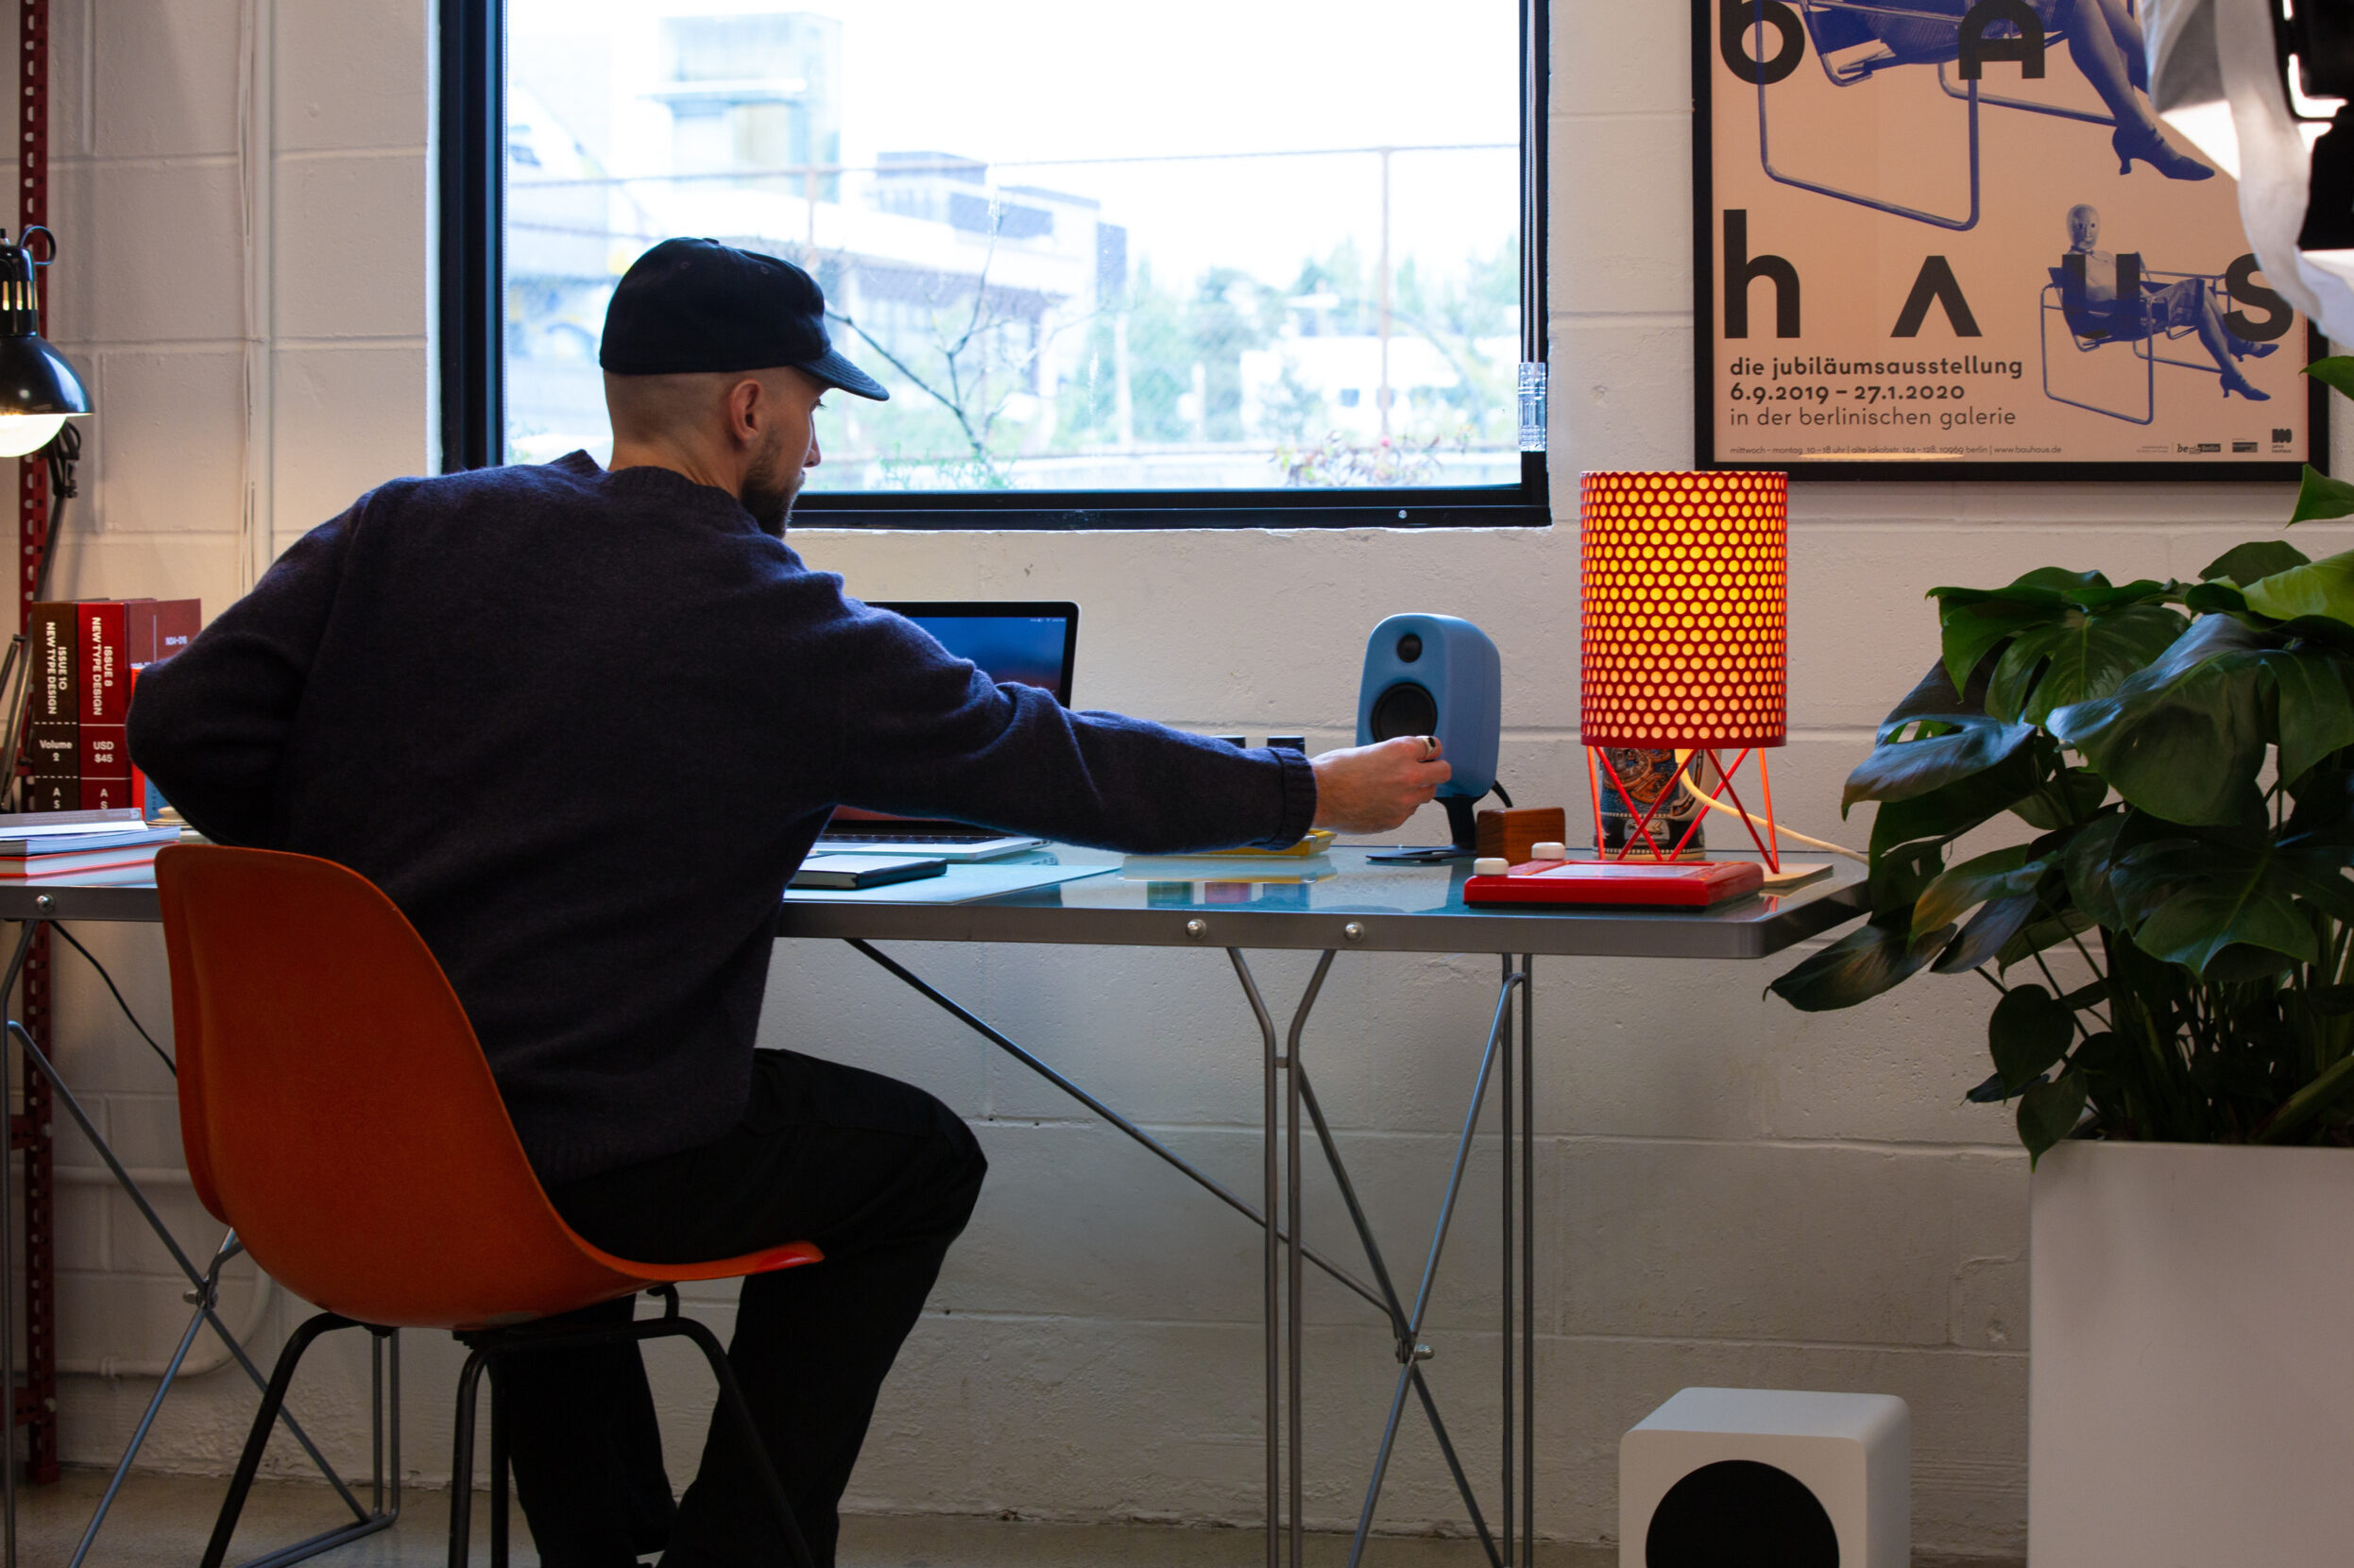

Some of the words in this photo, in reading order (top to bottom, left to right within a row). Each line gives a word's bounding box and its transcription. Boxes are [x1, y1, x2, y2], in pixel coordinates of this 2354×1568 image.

[1730, 356, 1766, 376] die
[1771, 354, 2023, 381] jubiläumsausstellung
[1730, 382, 1830, 405] 6.9.2019
[1854, 384, 1965, 405] 27.1.2020
[1730, 407, 1748, 426] in
[1756, 406, 1792, 426] der
[1799, 406, 1931, 426] berlinischen
[1939, 406, 2017, 431] galerie
[1730, 446, 1766, 454] mittwoch
[1772, 446, 1803, 456] montag
[1965, 446, 1988, 454] berlin
[1993, 446, 2063, 454] www.bauhaus.de
[45, 622, 56, 648] NEW
[92, 617, 102, 643] NEW
[46, 649, 56, 673] TYPE
[58, 646, 68, 675] ISSUE
[93, 644, 102, 672] TYPE
[103, 646, 113, 678] ISSUE
[47, 675, 57, 715] DESIGN
[93, 673, 103, 716] DESIGN
[39, 740, 73, 749] Volume
[93, 741, 114, 751] USD
[94, 753, 114, 763] $45
